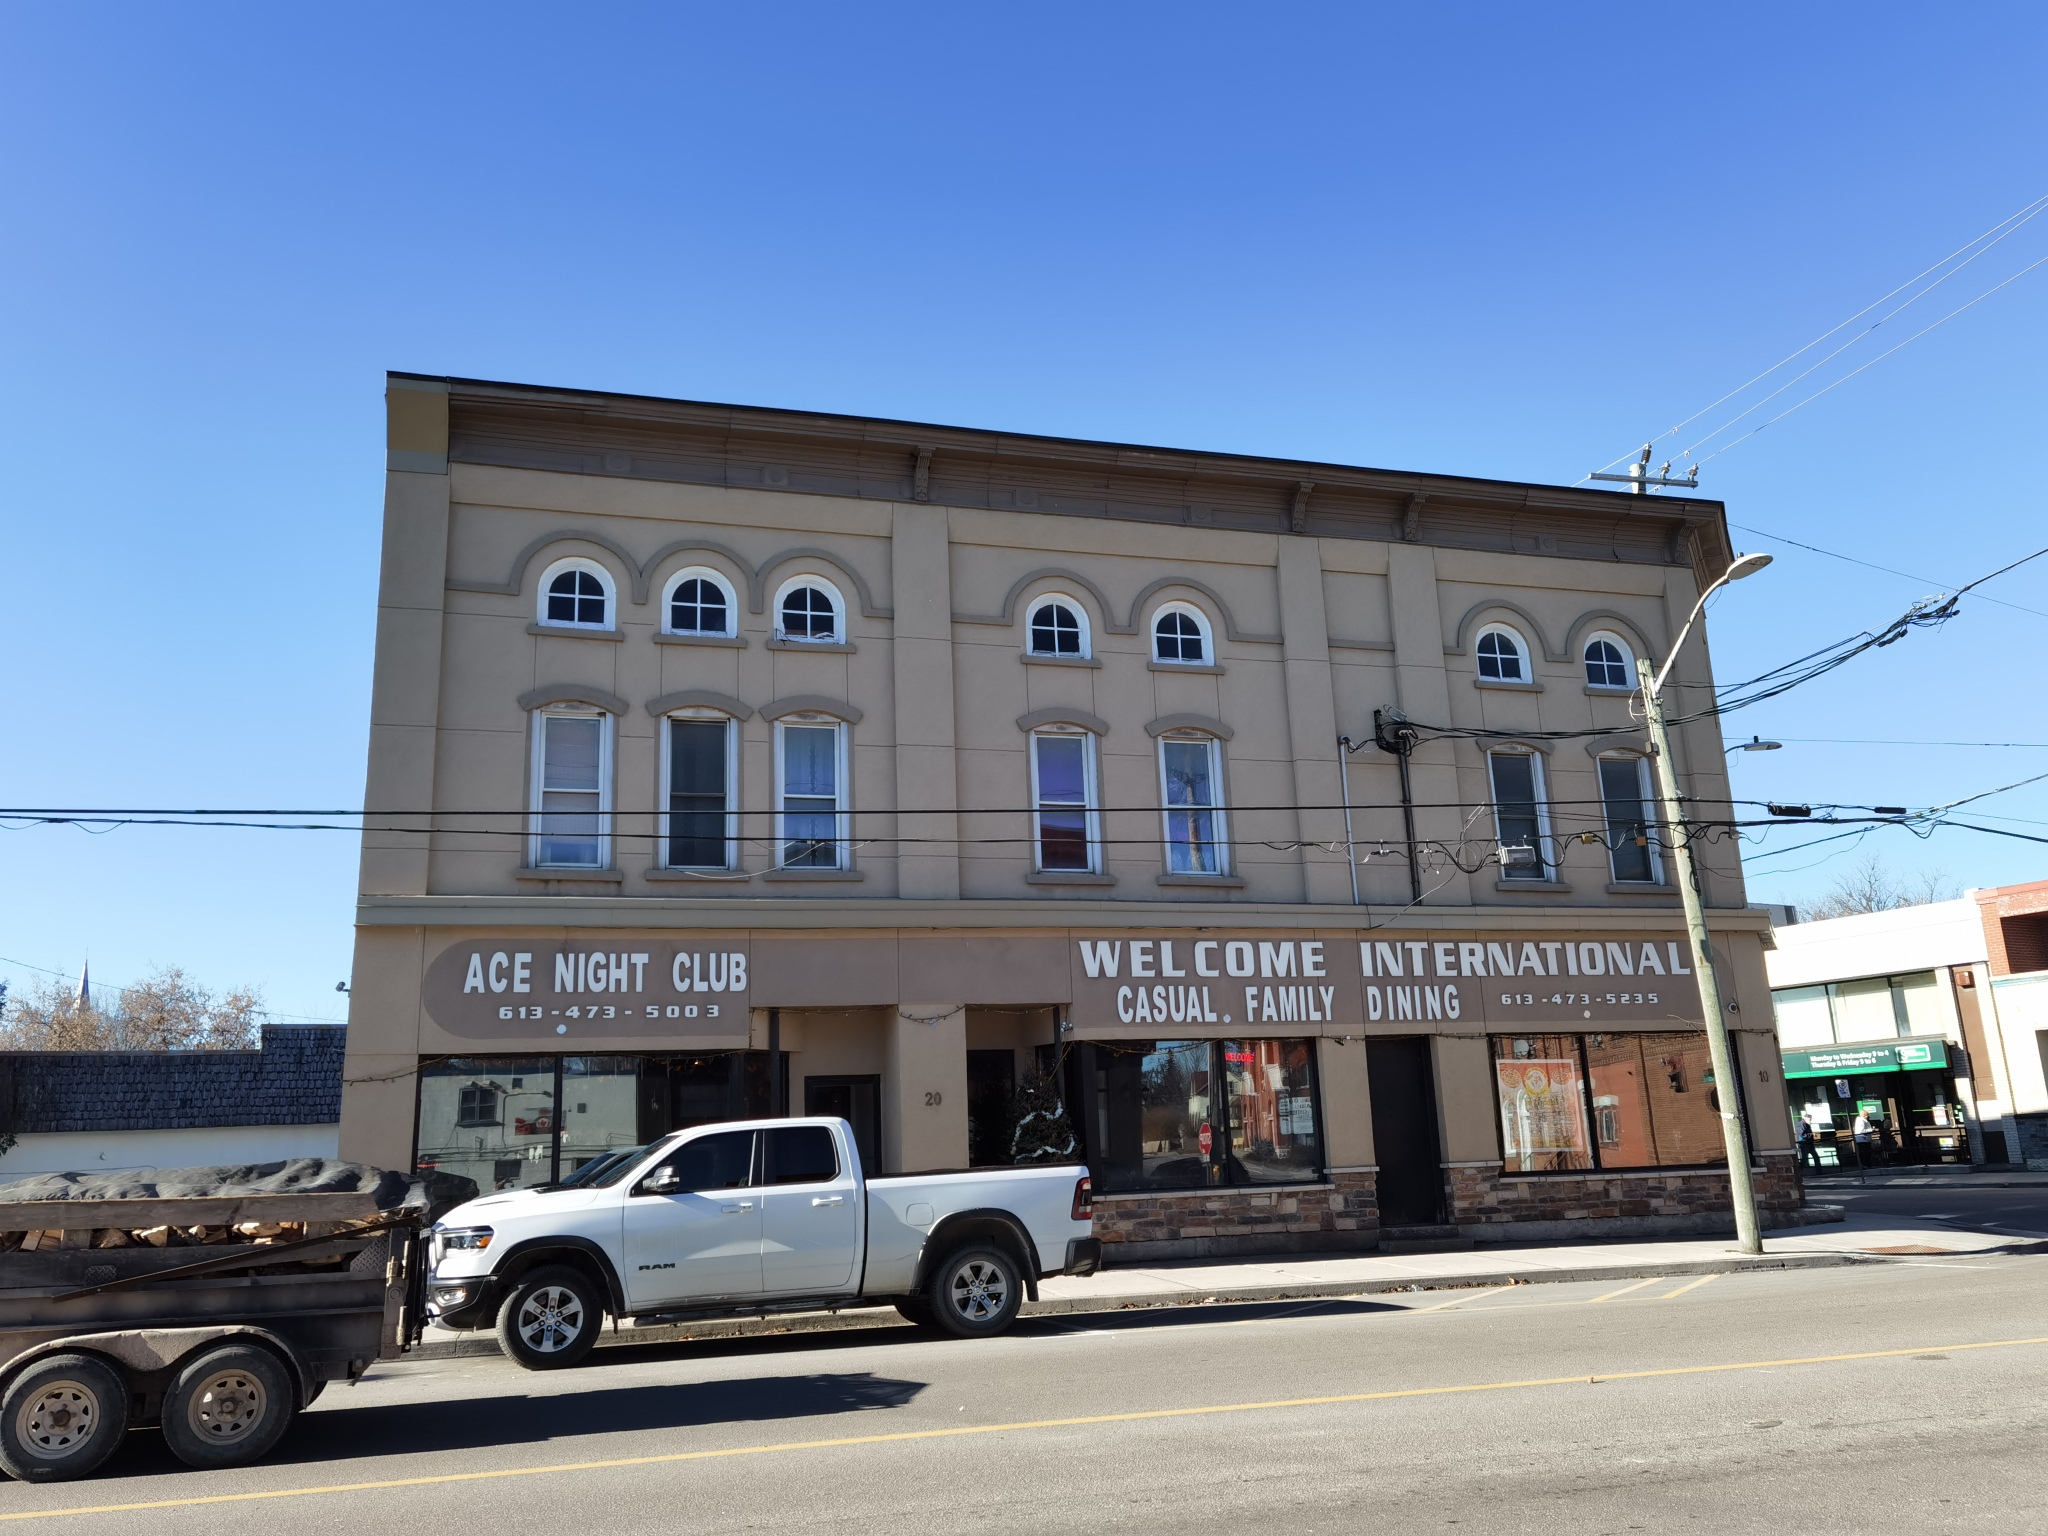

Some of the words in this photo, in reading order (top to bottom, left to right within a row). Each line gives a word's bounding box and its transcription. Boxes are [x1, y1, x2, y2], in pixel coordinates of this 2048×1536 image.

[1078, 940, 1326, 978] WELCOME
[1359, 941, 1691, 977] INTERNATIONAL
[463, 952, 532, 994] ACE
[554, 951, 649, 993] NIGHT
[672, 952, 748, 992] CLUB
[1245, 985, 1335, 1022] FAMILY
[1366, 984, 1460, 1021] DINING
[1225, 1052, 1254, 1061] WELCOME
[1840, 1051, 1872, 1059] Wednesday
[1758, 1070, 1770, 1083] 10
[924, 1091, 943, 1107] 20
[638, 1262, 676, 1271] RAM
